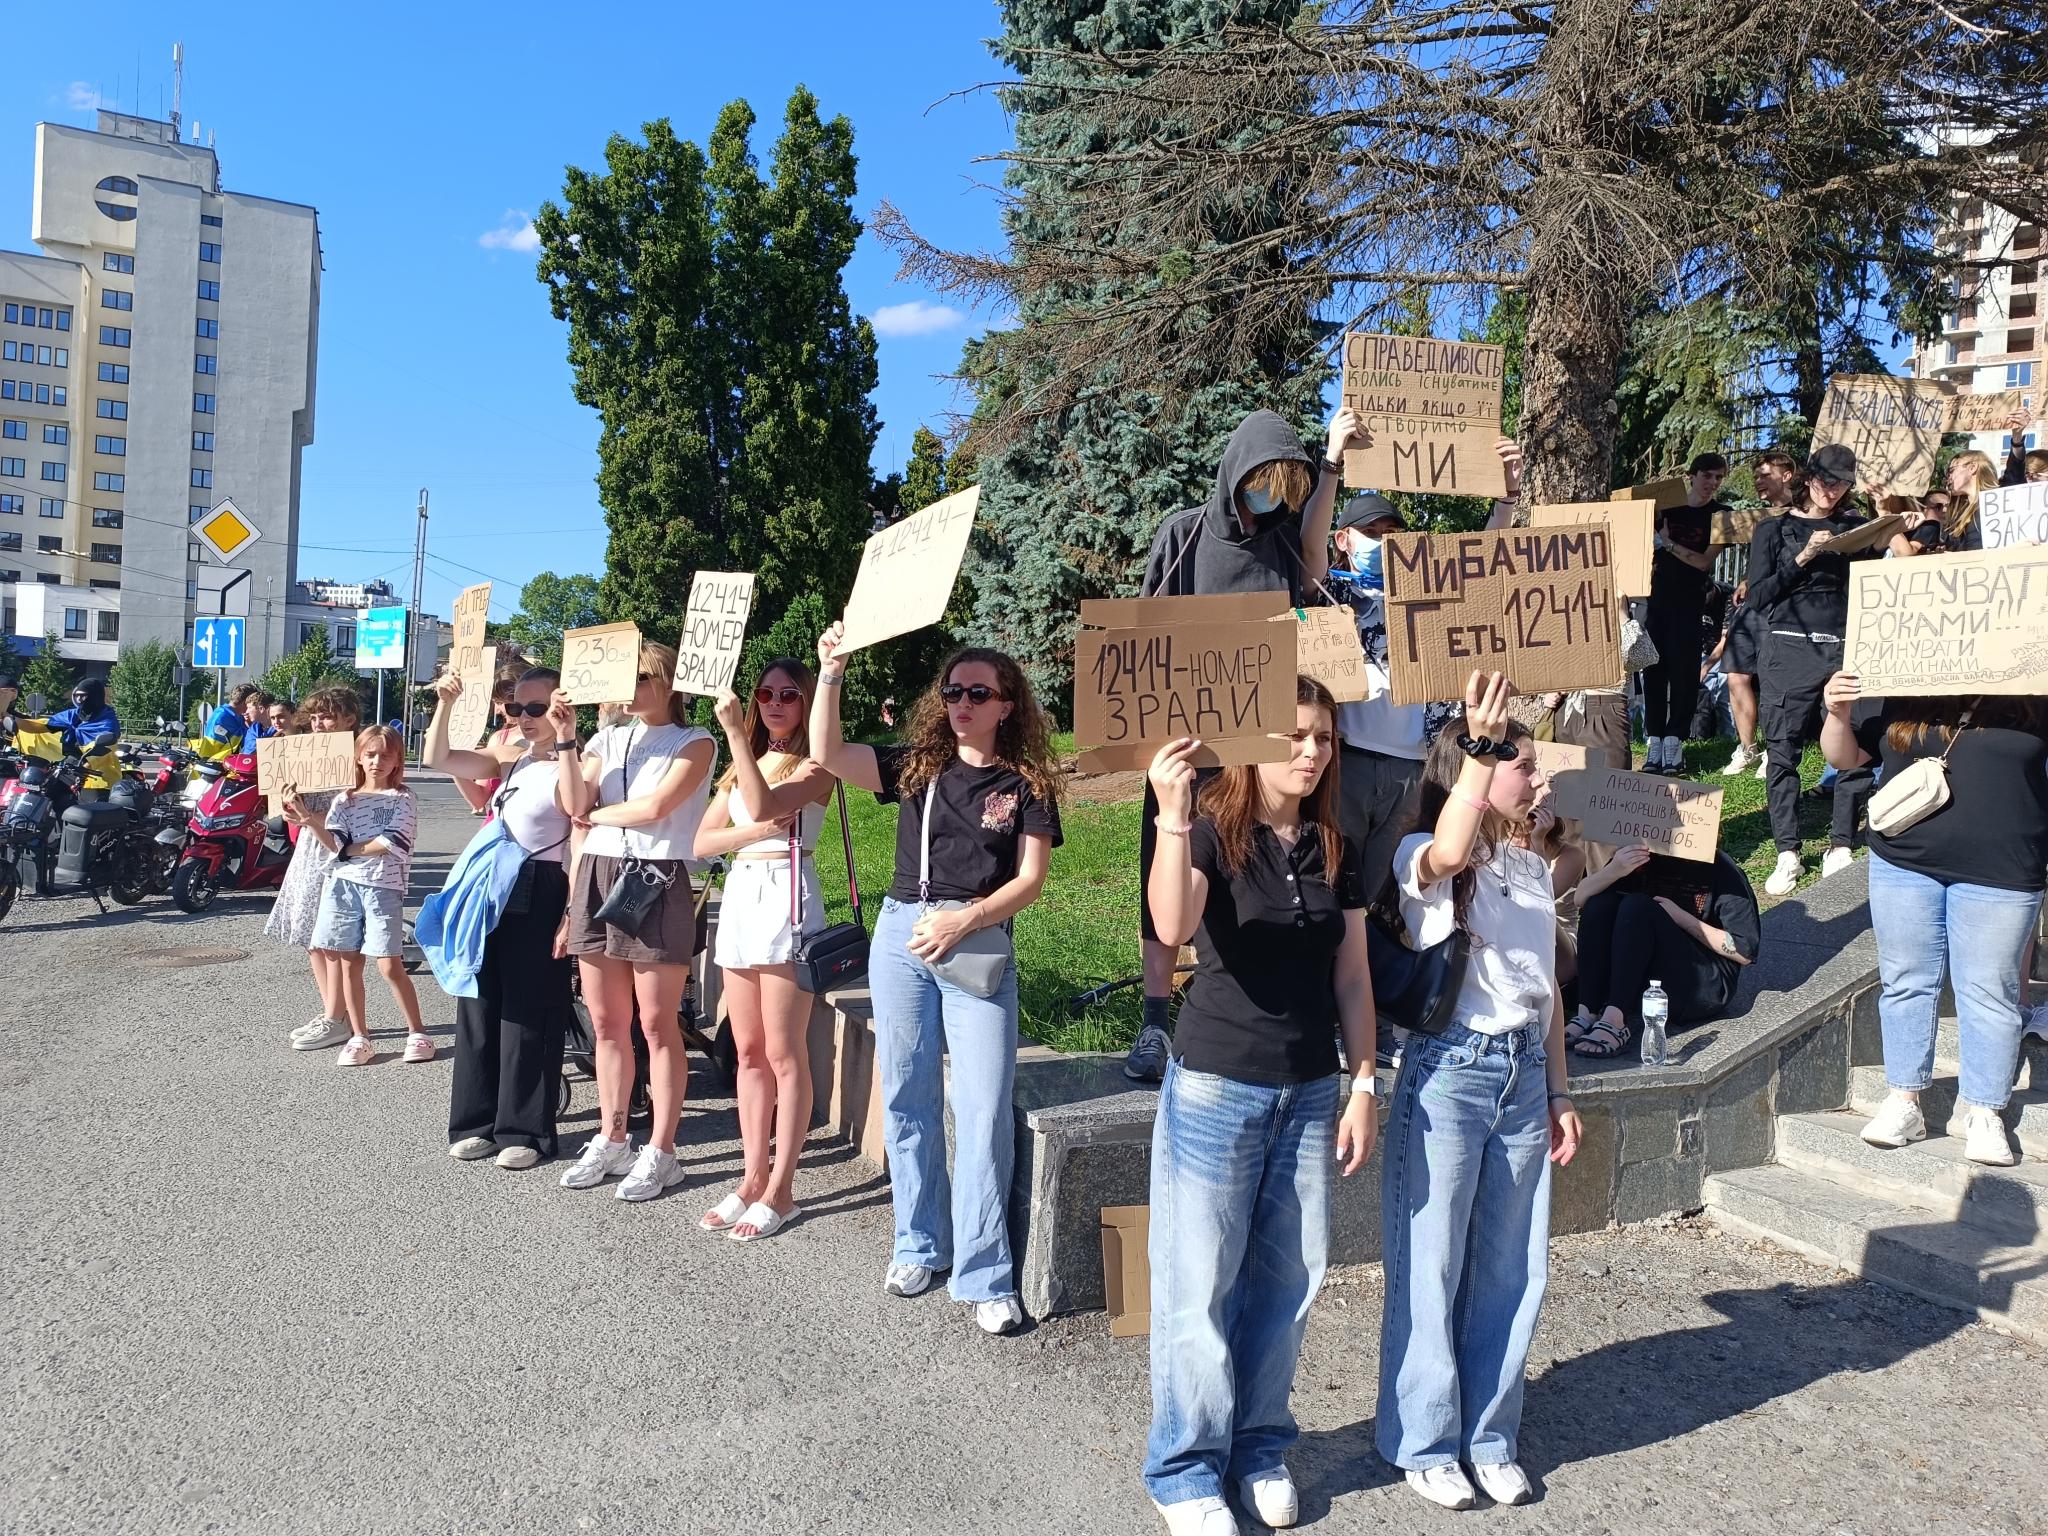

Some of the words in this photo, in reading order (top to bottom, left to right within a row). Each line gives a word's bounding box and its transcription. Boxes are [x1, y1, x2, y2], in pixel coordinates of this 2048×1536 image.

[1347, 336, 1501, 378] СПРАВЕДЛИВІСТЬ
[1345, 394, 1407, 414] ТІЛЬКИ
[1422, 400, 1465, 419] ЯКЩО
[1948, 407, 1993, 421] НОМЕР
[1853, 429, 1890, 458] НЕ
[1393, 440, 1457, 489] МИ
[690, 582, 752, 615] 12414
[1860, 562, 2048, 610] БУДУВАТ
[1504, 580, 1612, 649] 12414
[681, 617, 744, 652] НОМЕР
[1298, 632, 1357, 655] РСТВО
[1855, 637, 1975, 661] РУЙНУВАТИ
[575, 636, 618, 666] 236
[567, 669, 592, 690] 30
[676, 652, 735, 692] ЗРАДИ
[1852, 657, 1979, 676] ХВИЛИНАМИ
[1107, 683, 1262, 741] ЗРАДИ
[264, 734, 332, 759] 12414
[260, 755, 312, 791] ЗАКОН
[1606, 775, 1650, 794] ЛЮДИ
[1589, 795, 1597, 808] А
[1600, 796, 1617, 811] ВІН
